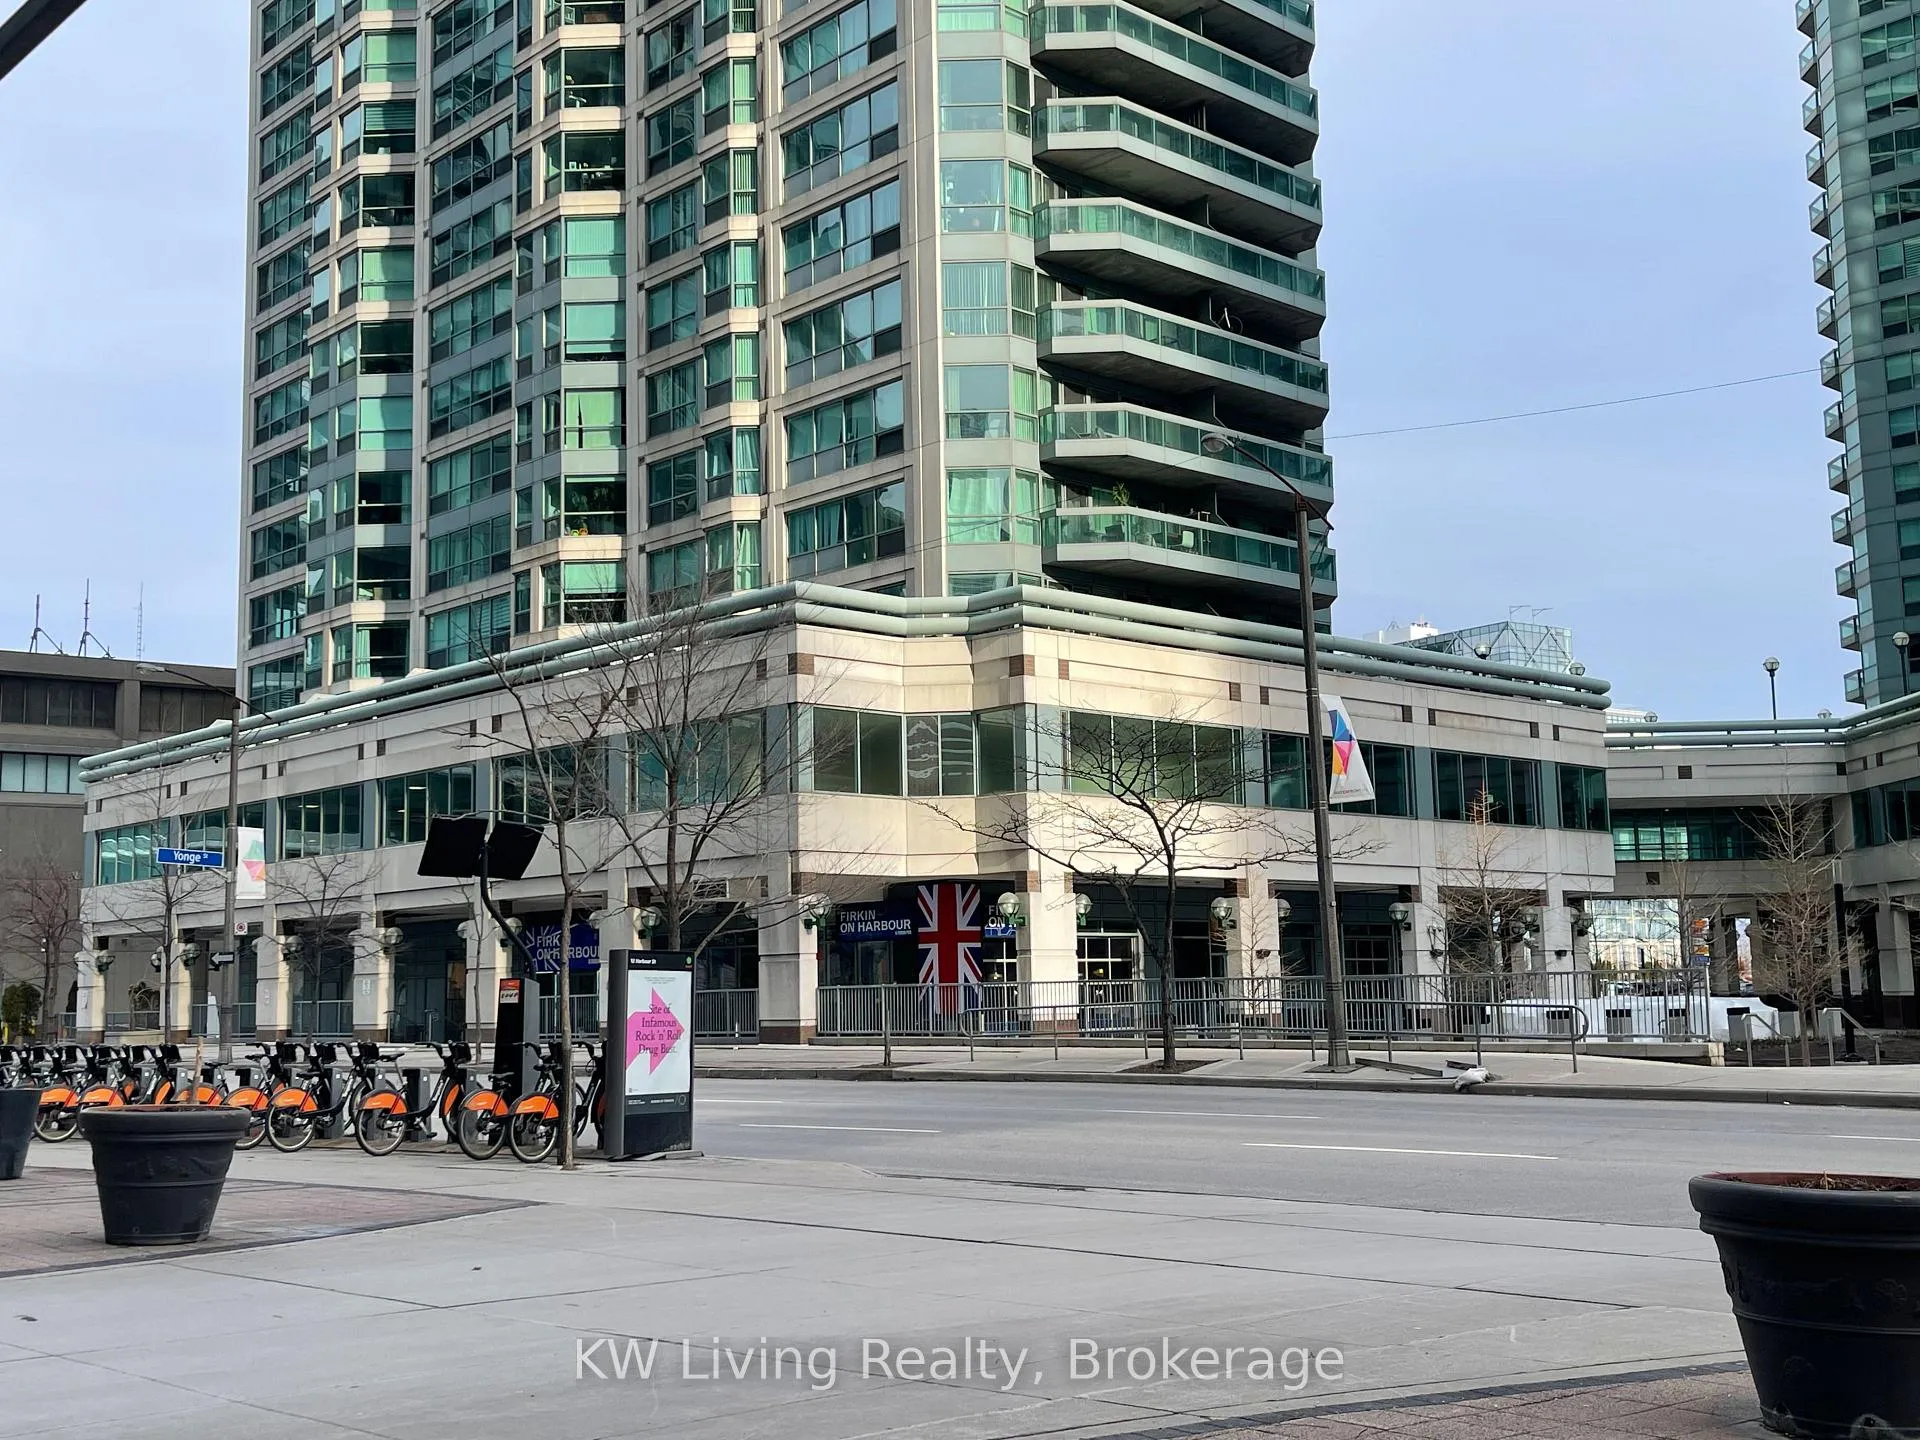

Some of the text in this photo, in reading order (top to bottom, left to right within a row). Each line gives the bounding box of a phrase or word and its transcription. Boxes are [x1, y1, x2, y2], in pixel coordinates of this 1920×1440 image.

[173, 850, 201, 864] Yonge
[840, 909, 876, 922] FIRKIN
[840, 922, 855, 933] ON
[857, 919, 911, 933] HARBOUR
[649, 1003, 672, 1014] Site of
[641, 1016, 677, 1028] Infamous
[635, 1029, 656, 1041] Rock
[638, 1043, 659, 1057] Drug
